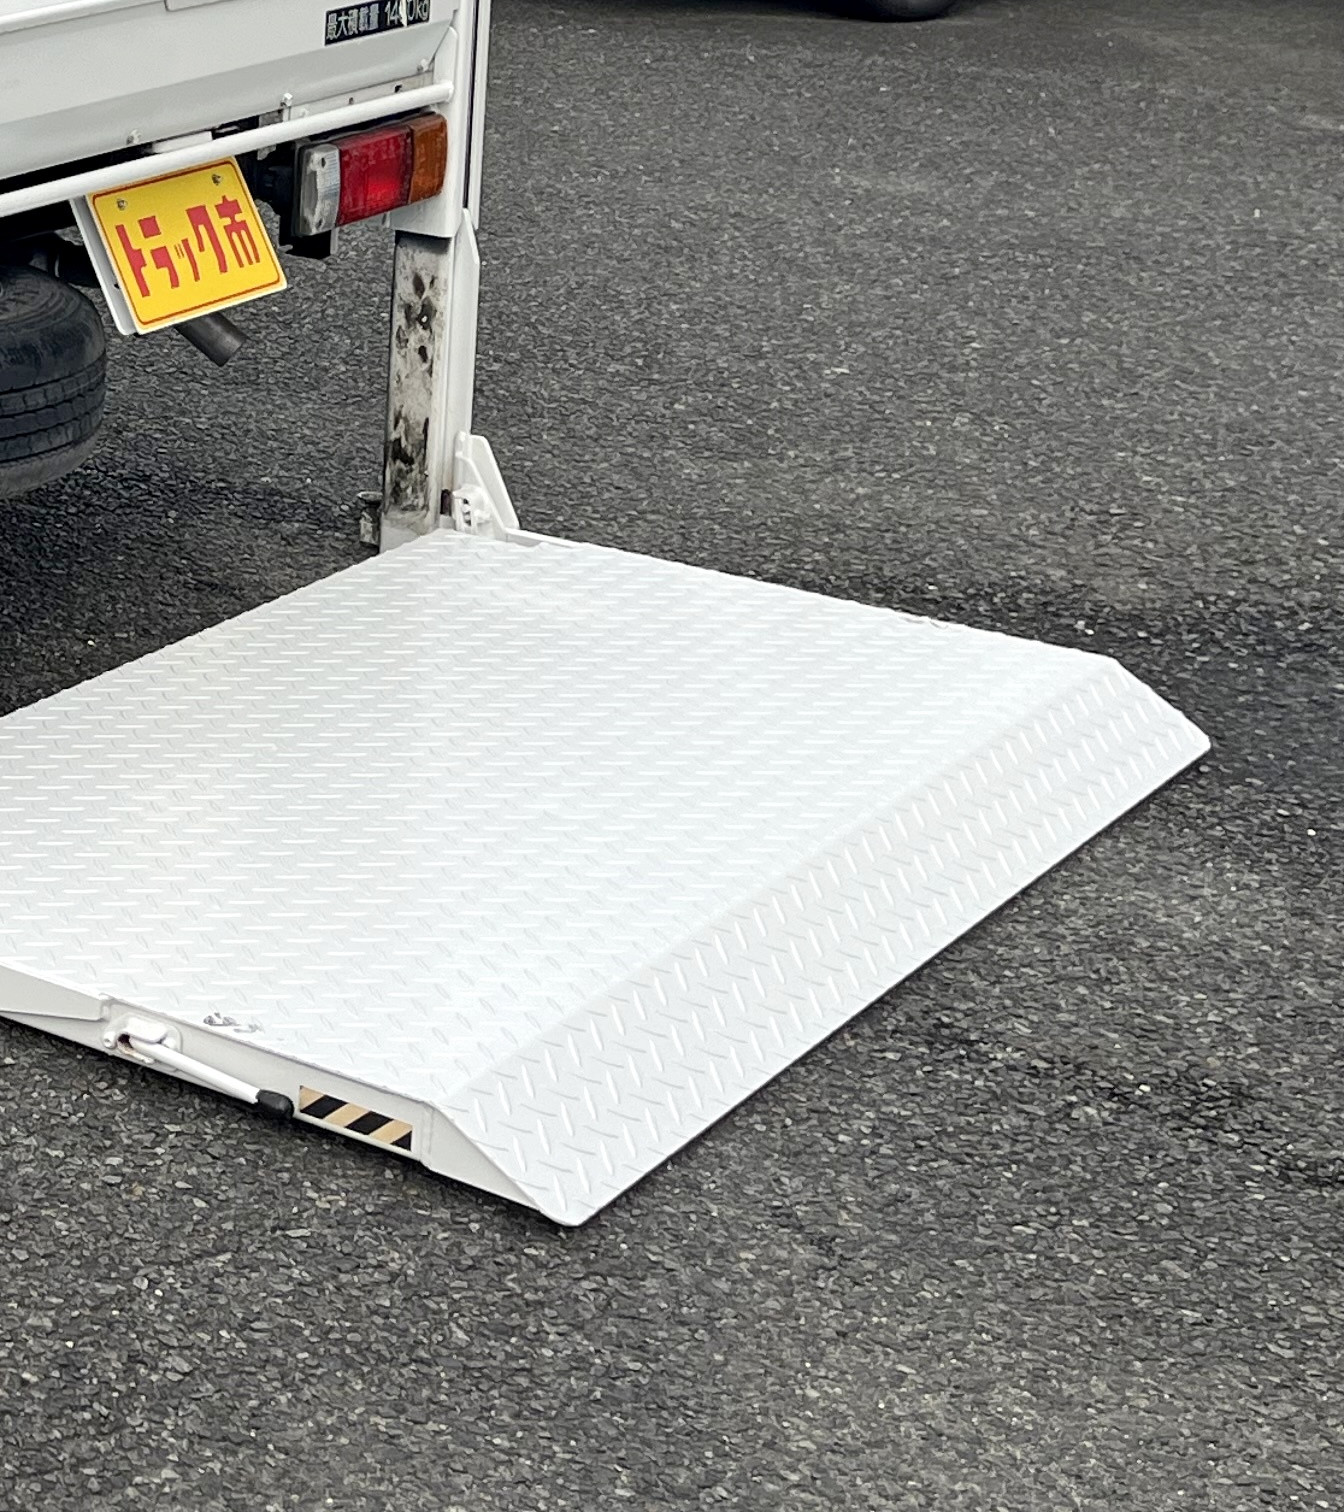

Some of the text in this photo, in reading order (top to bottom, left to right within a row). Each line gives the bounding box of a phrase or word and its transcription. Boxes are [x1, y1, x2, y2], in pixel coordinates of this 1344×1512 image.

[115, 195, 261, 298] トラック市
